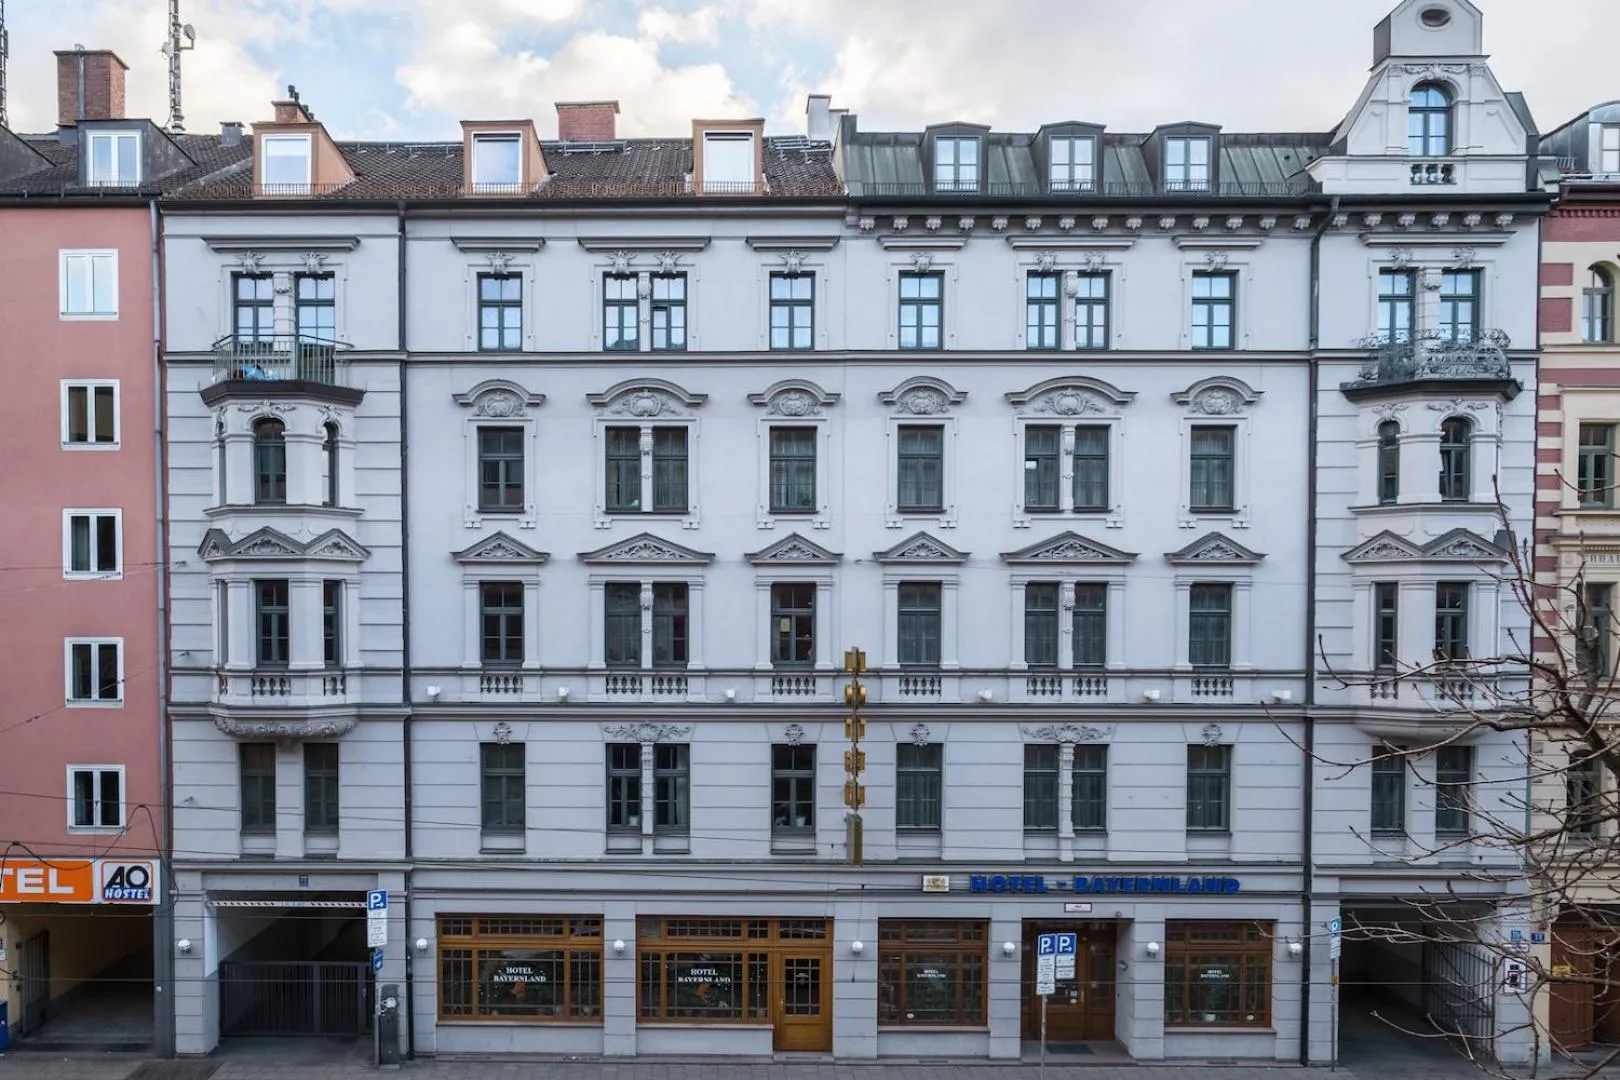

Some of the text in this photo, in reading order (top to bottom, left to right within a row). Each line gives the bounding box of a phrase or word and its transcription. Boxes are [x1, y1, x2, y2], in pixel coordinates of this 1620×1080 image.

[105, 865, 150, 888] AO
[970, 875, 1048, 893] HOTEL
[1073, 875, 1240, 894] BAYERNLAND
[104, 888, 150, 900] HOSTEL
[370, 892, 382, 909] P
[1041, 937, 1051, 954] P
[1059, 936, 1070, 953] P
[493, 975, 546, 983] BAYERNLAND
[690, 968, 718, 976] HOTEL
